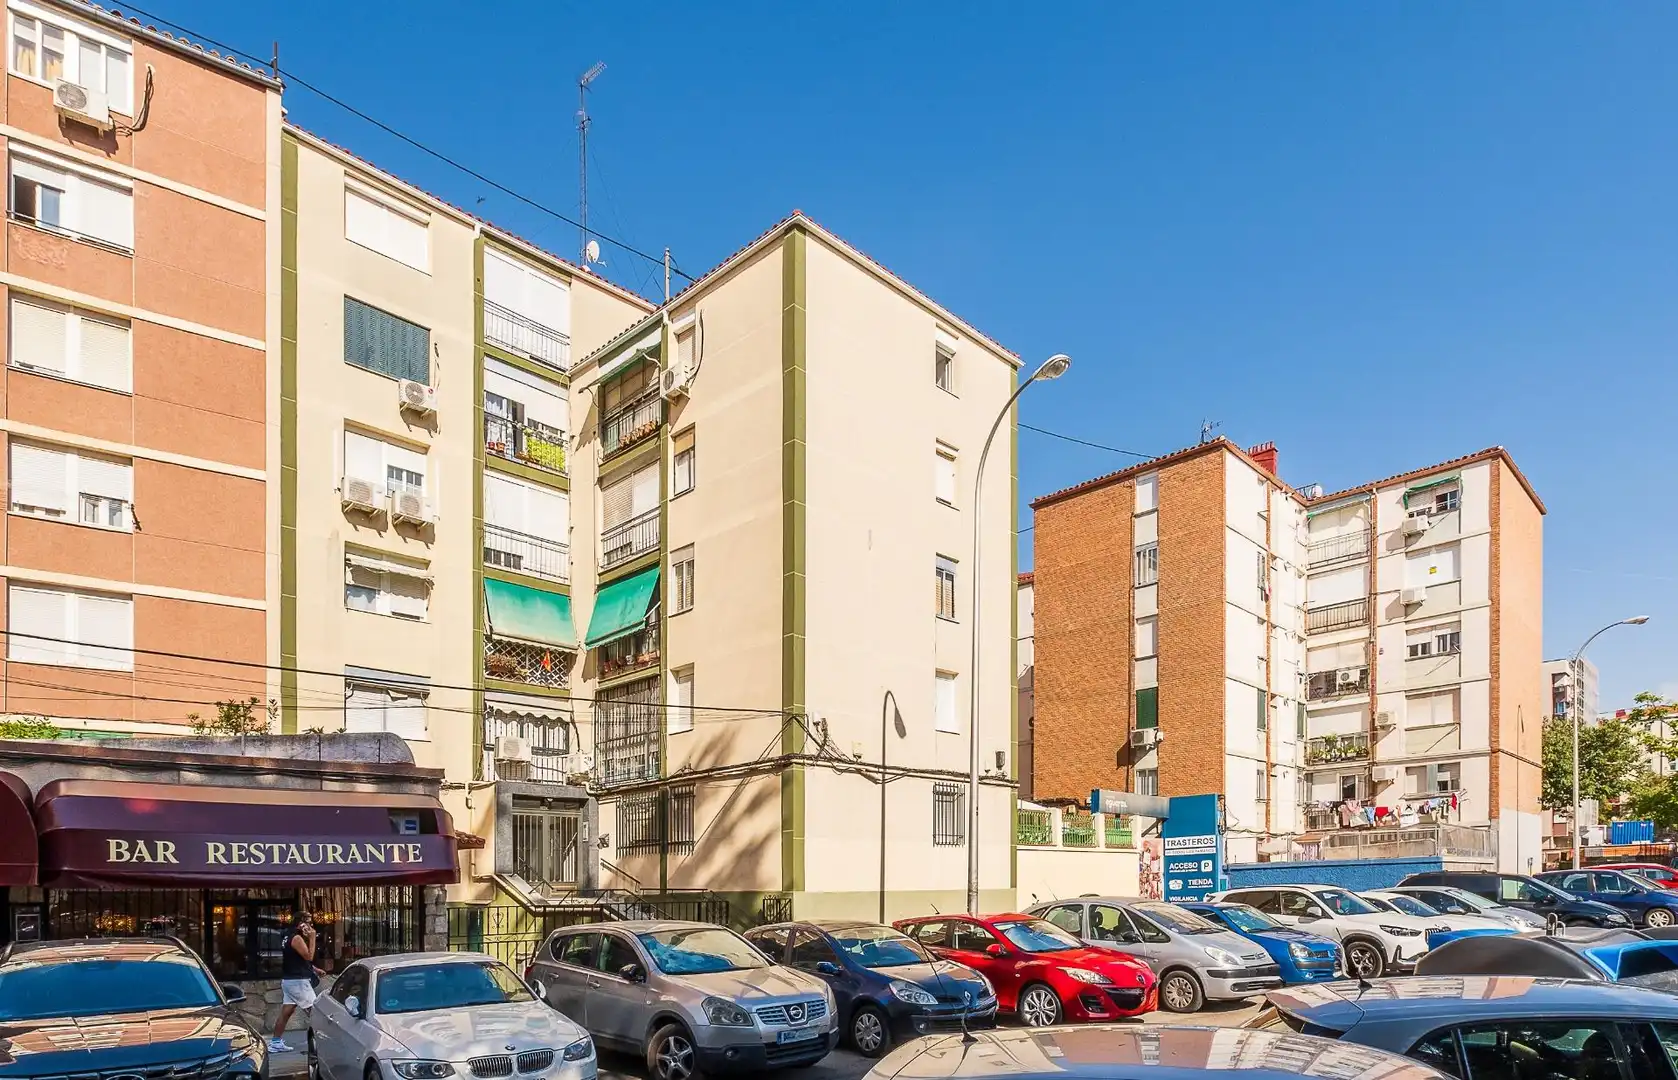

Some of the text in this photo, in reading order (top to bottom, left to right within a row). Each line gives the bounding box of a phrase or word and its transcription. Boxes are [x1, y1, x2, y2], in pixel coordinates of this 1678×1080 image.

[1167, 837, 1215, 847] TRASTEROS
[106, 838, 424, 866] BAR RESTAURANTE
[1169, 862, 1198, 870] ACCESO
[1187, 878, 1213, 886] TIENDA
